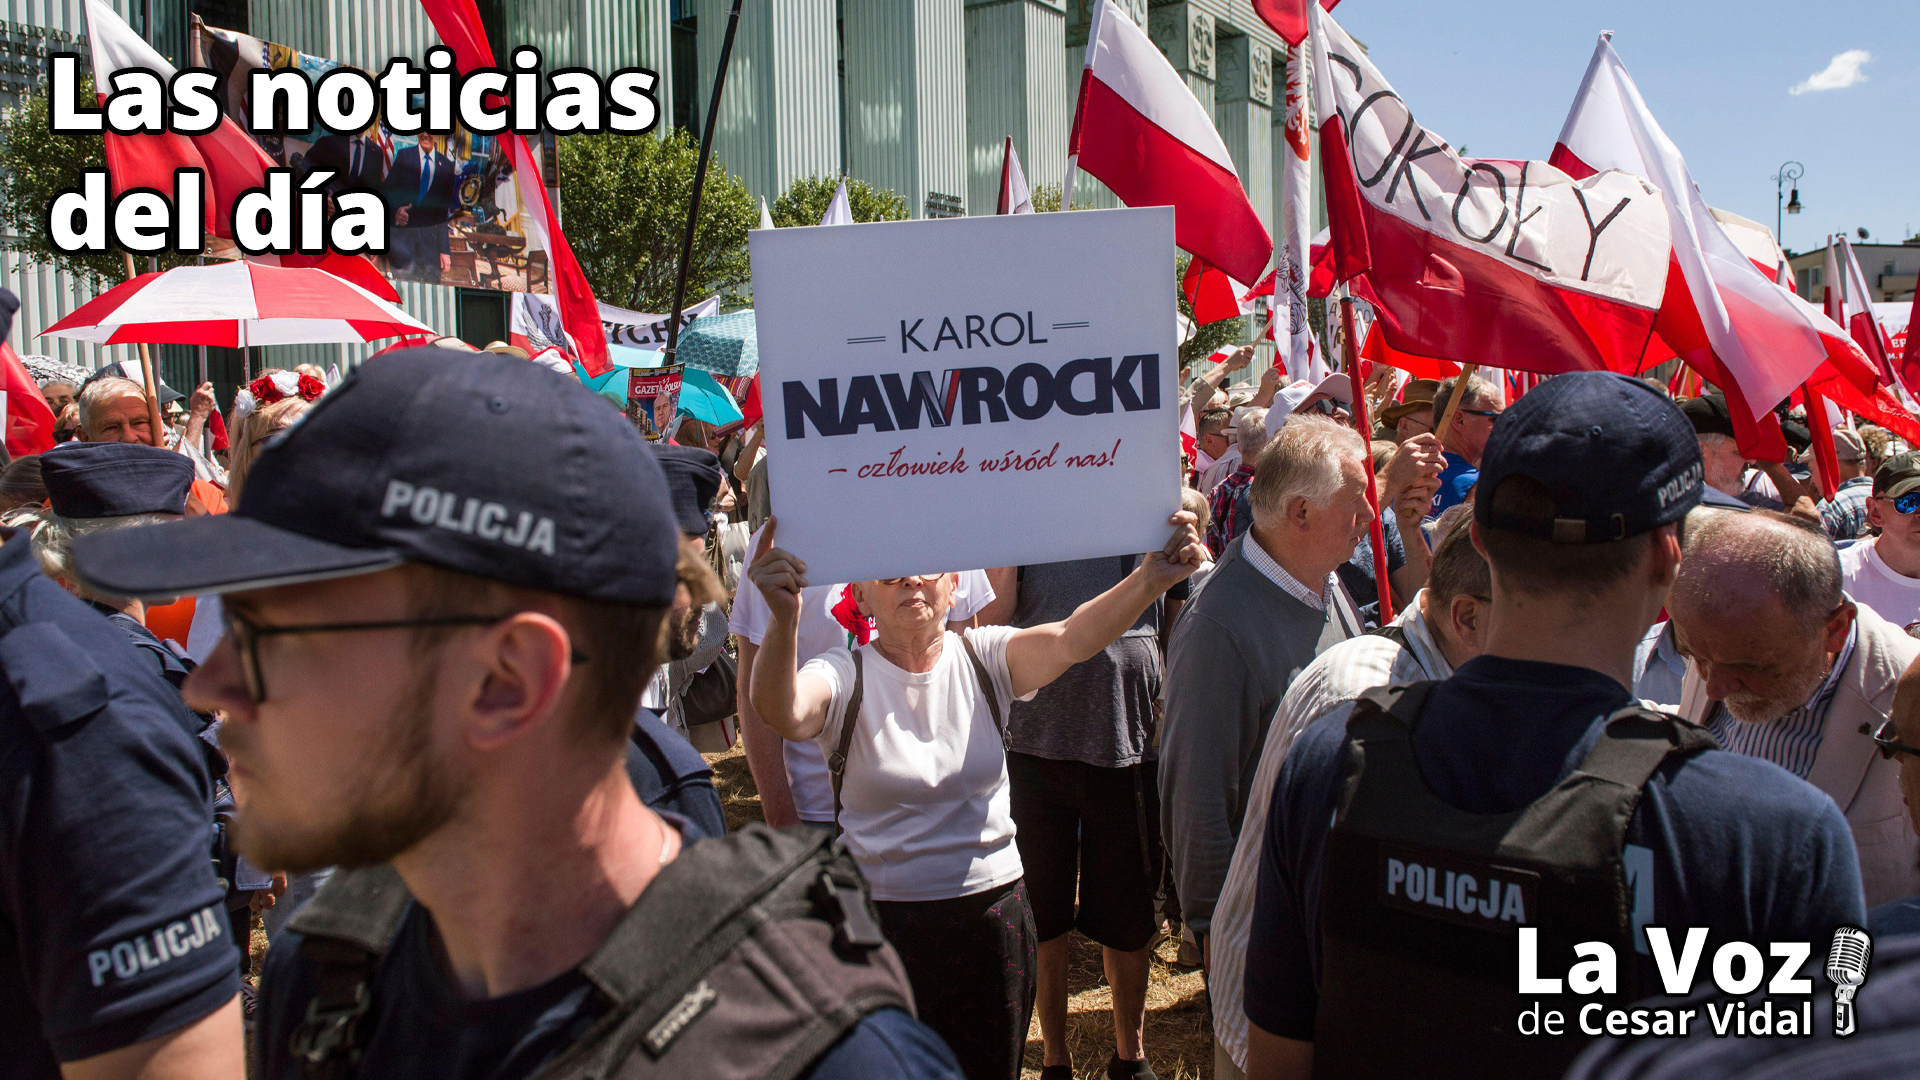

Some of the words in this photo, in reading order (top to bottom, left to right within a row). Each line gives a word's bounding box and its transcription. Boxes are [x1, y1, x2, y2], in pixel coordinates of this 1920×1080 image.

[900, 310, 1048, 354] KAROL
[634, 384, 663, 395] GAZETA
[781, 353, 1161, 440] NAWROCKI
[856, 445, 970, 479] człowiek
[979, 442, 1061, 472] wśród
[1064, 438, 1122, 468] nas!
[381, 478, 557, 557] POLICJA
[1387, 857, 1527, 924] POLICJA
[88, 906, 222, 987] POLICJA
